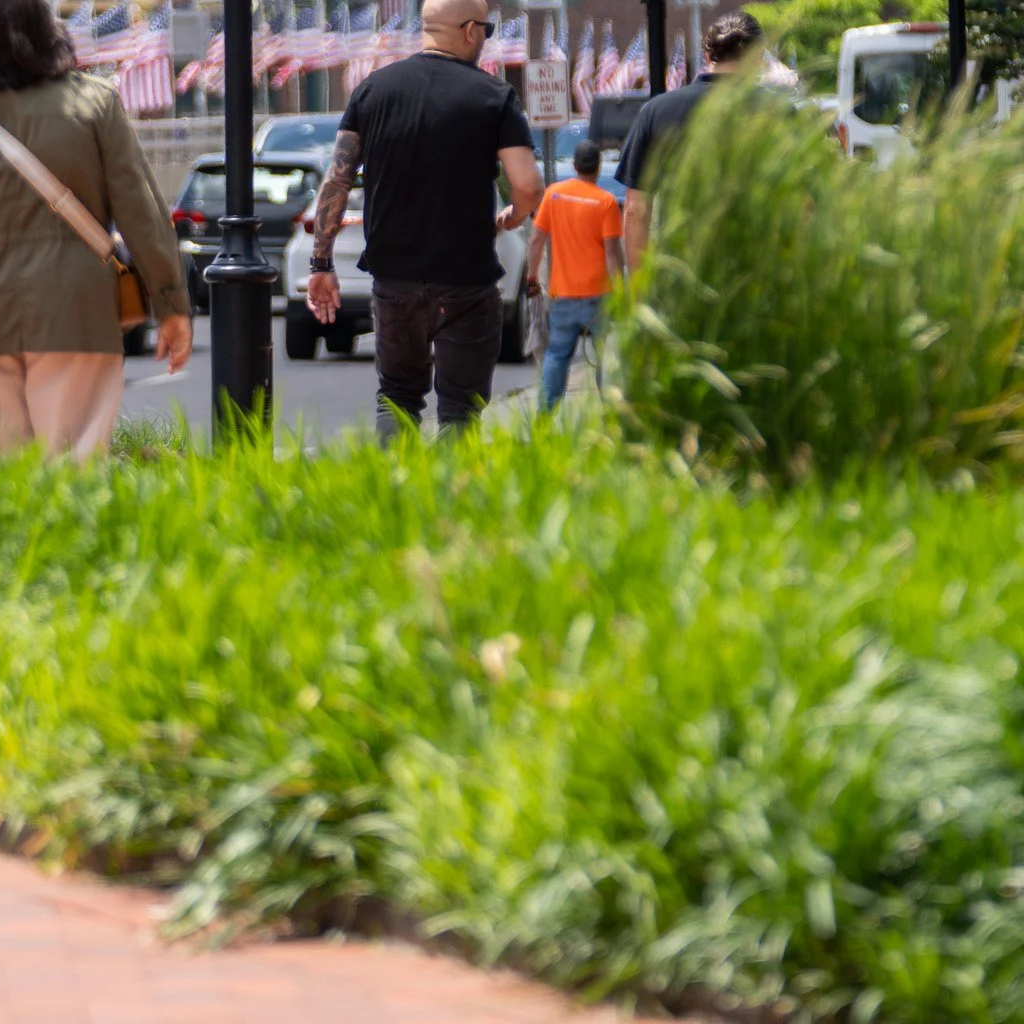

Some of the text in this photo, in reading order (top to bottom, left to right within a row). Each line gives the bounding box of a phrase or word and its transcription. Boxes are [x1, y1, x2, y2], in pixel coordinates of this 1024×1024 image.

[539, 66, 555, 78] NO
[528, 81, 566, 93] PARKING
[540, 95, 555, 103] ANY
